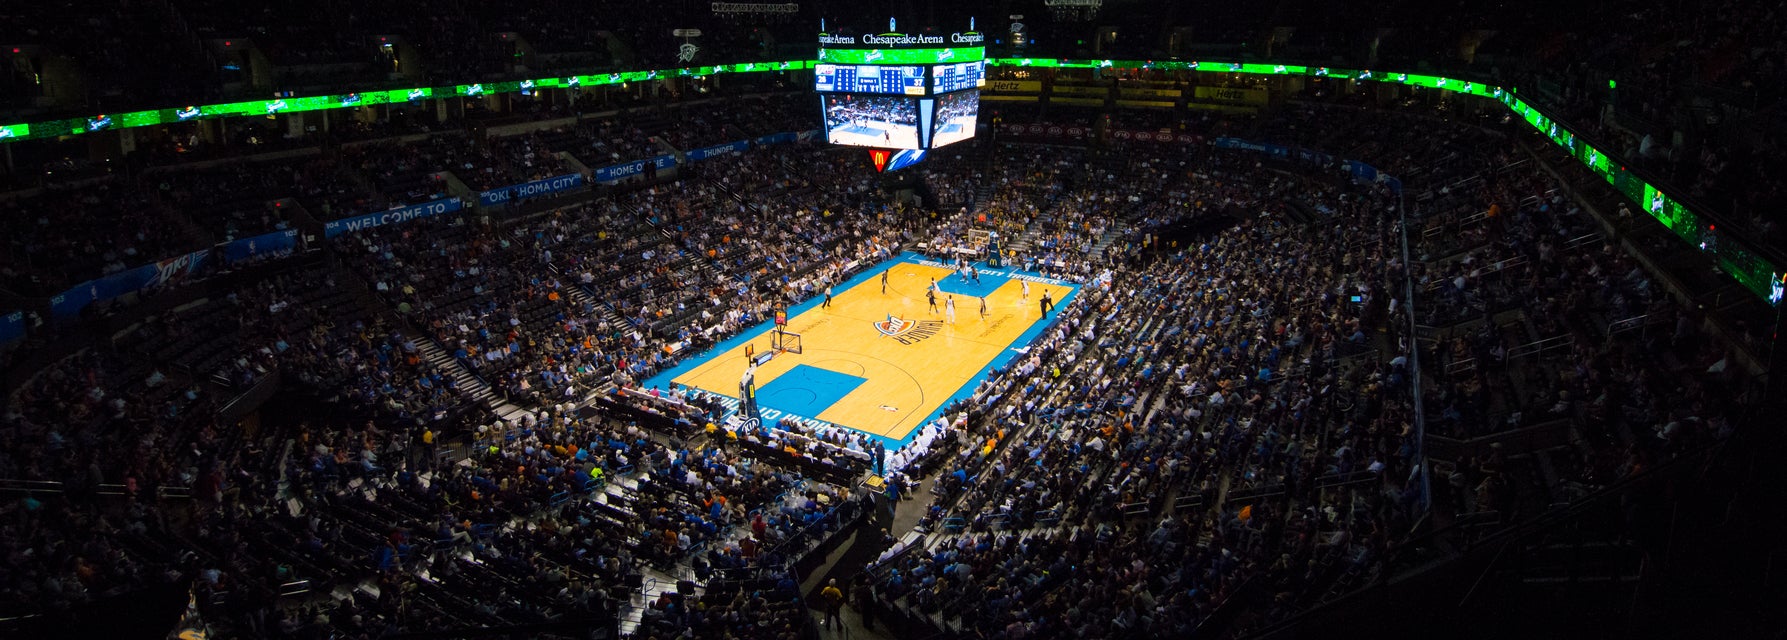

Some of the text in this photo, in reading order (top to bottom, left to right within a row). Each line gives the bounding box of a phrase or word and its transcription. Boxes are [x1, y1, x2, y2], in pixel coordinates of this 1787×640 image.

[834, 34, 855, 44] Arena
[863, 34, 943, 47] Chesapeake Arena
[994, 82, 1019, 90] Hertz
[1215, 89, 1243, 99] Hertz
[610, 164, 634, 177] HOME
[489, 182, 550, 202] OKLHOMA
[552, 177, 575, 189] CITY
[326, 221, 340, 229] 104
[346, 207, 422, 232] WELCOME
[427, 203, 446, 215] TO
[160, 254, 189, 283] OKC
[1007, 273, 1060, 286] THUNDER
[892, 320, 944, 345] THUNDER
